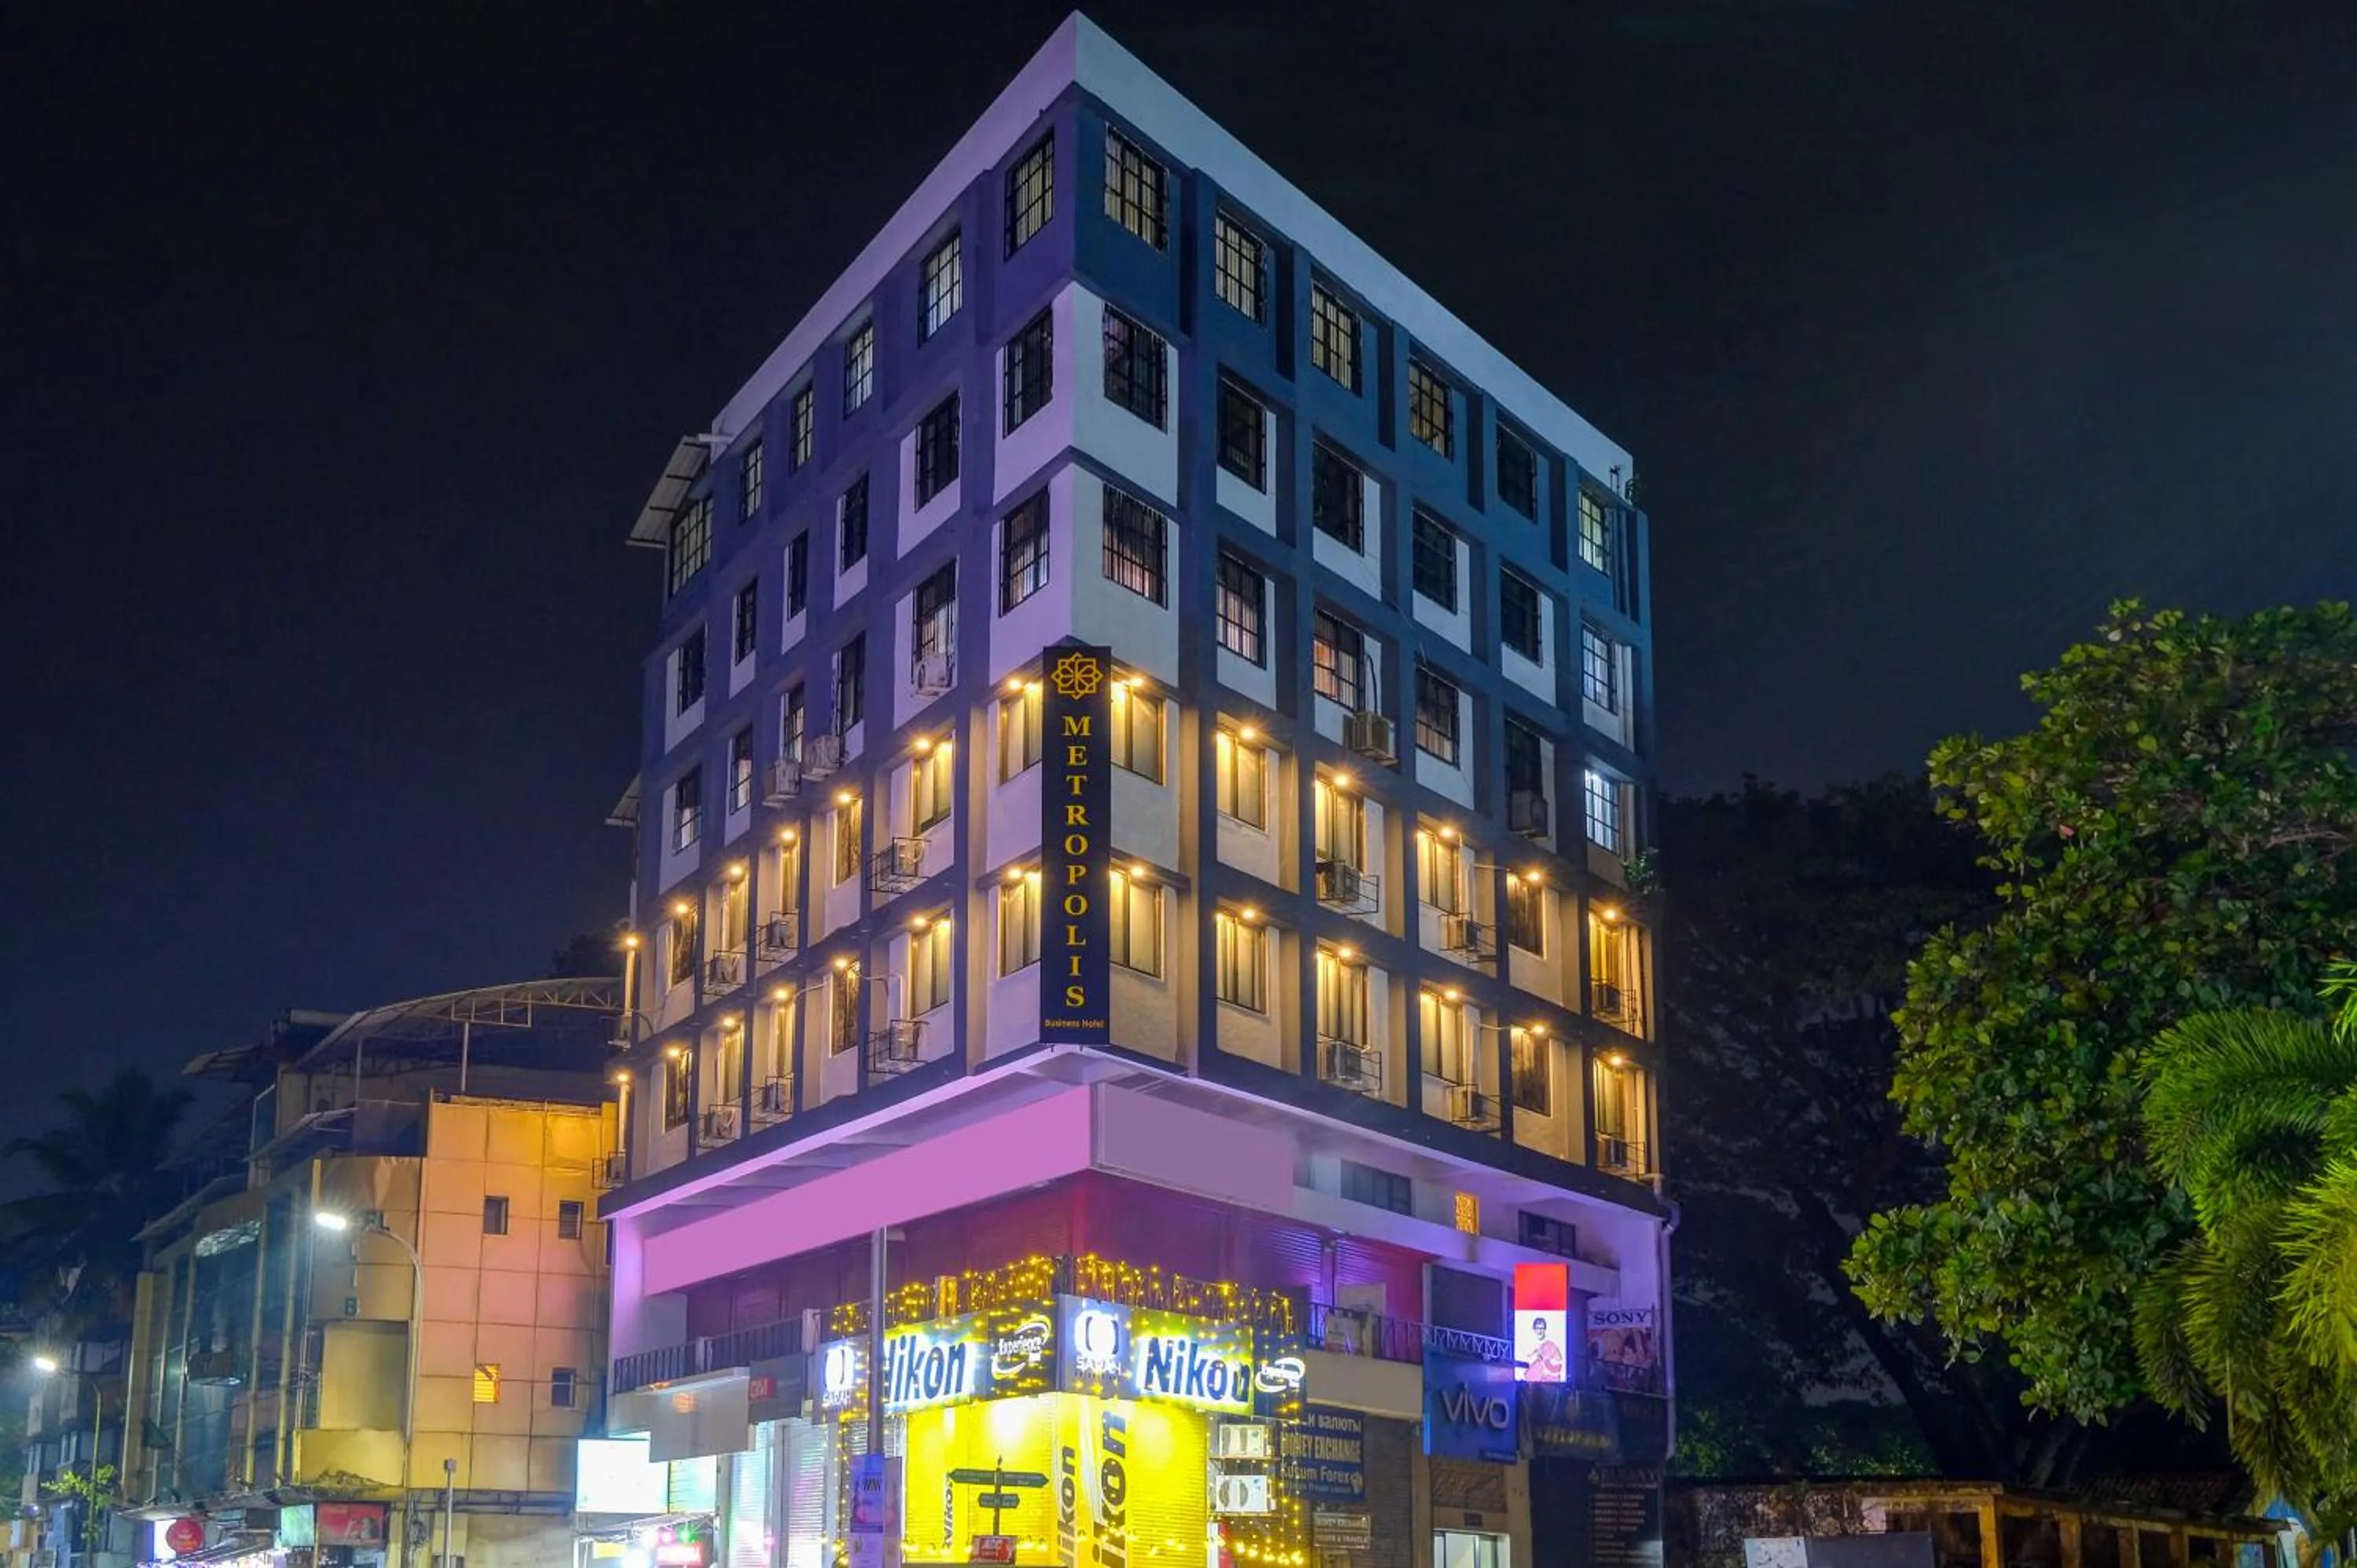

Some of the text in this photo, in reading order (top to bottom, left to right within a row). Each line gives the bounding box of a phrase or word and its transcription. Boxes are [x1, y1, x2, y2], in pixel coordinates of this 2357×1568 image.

[1062, 716, 1093, 1007] METROPOLIS
[1044, 1018, 1105, 1028] Business Hotel
[1593, 1310, 1648, 1324] SONY
[1144, 1336, 1252, 1403] Nikon
[1314, 1436, 1362, 1463] EXCHANGE
[1321, 1466, 1350, 1484] Forex
